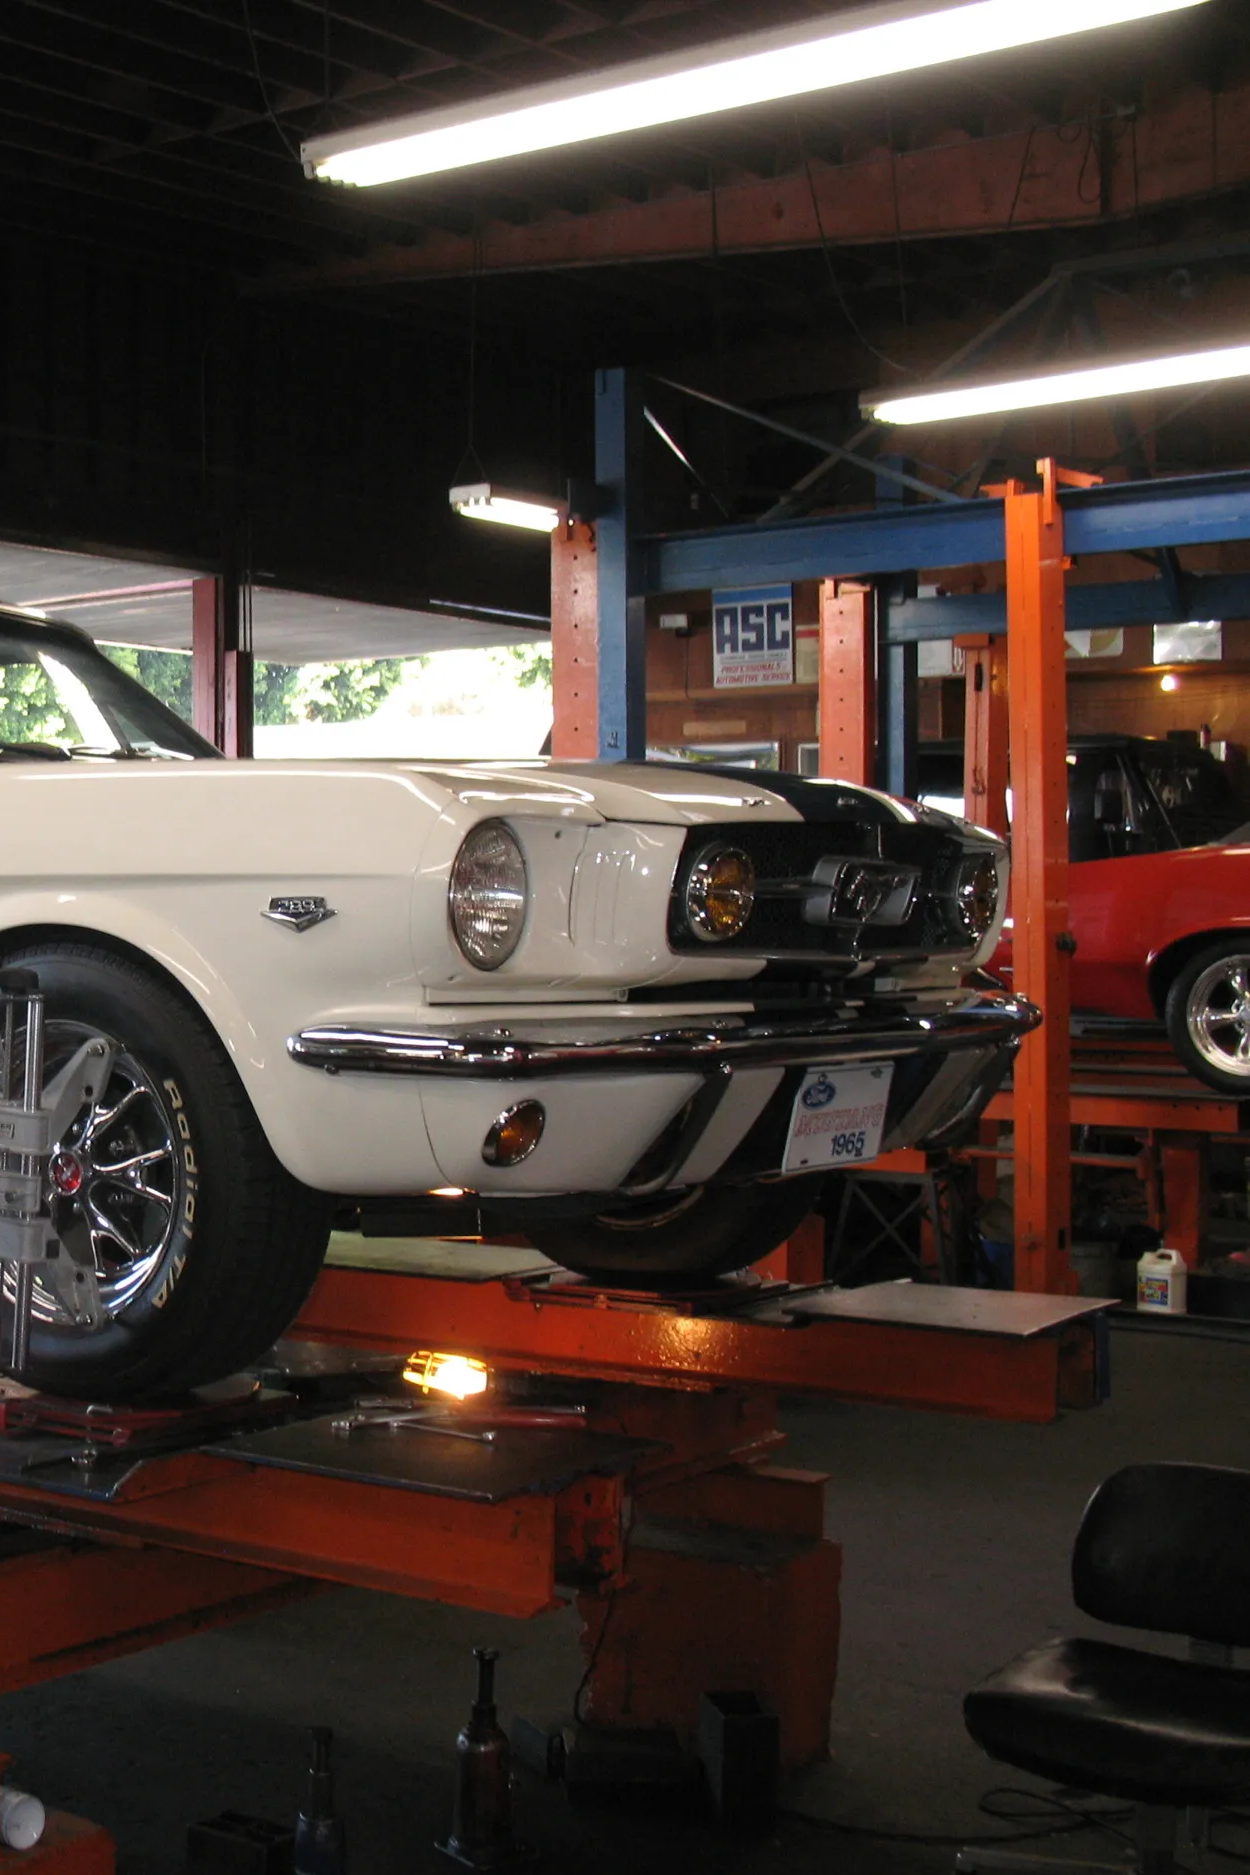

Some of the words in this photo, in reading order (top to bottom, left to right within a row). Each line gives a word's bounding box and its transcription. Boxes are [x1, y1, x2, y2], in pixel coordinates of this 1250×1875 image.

[715, 603, 790, 654] ASC
[716, 674, 759, 685] AUTOMOTIVE
[831, 1130, 866, 1157] 1965
